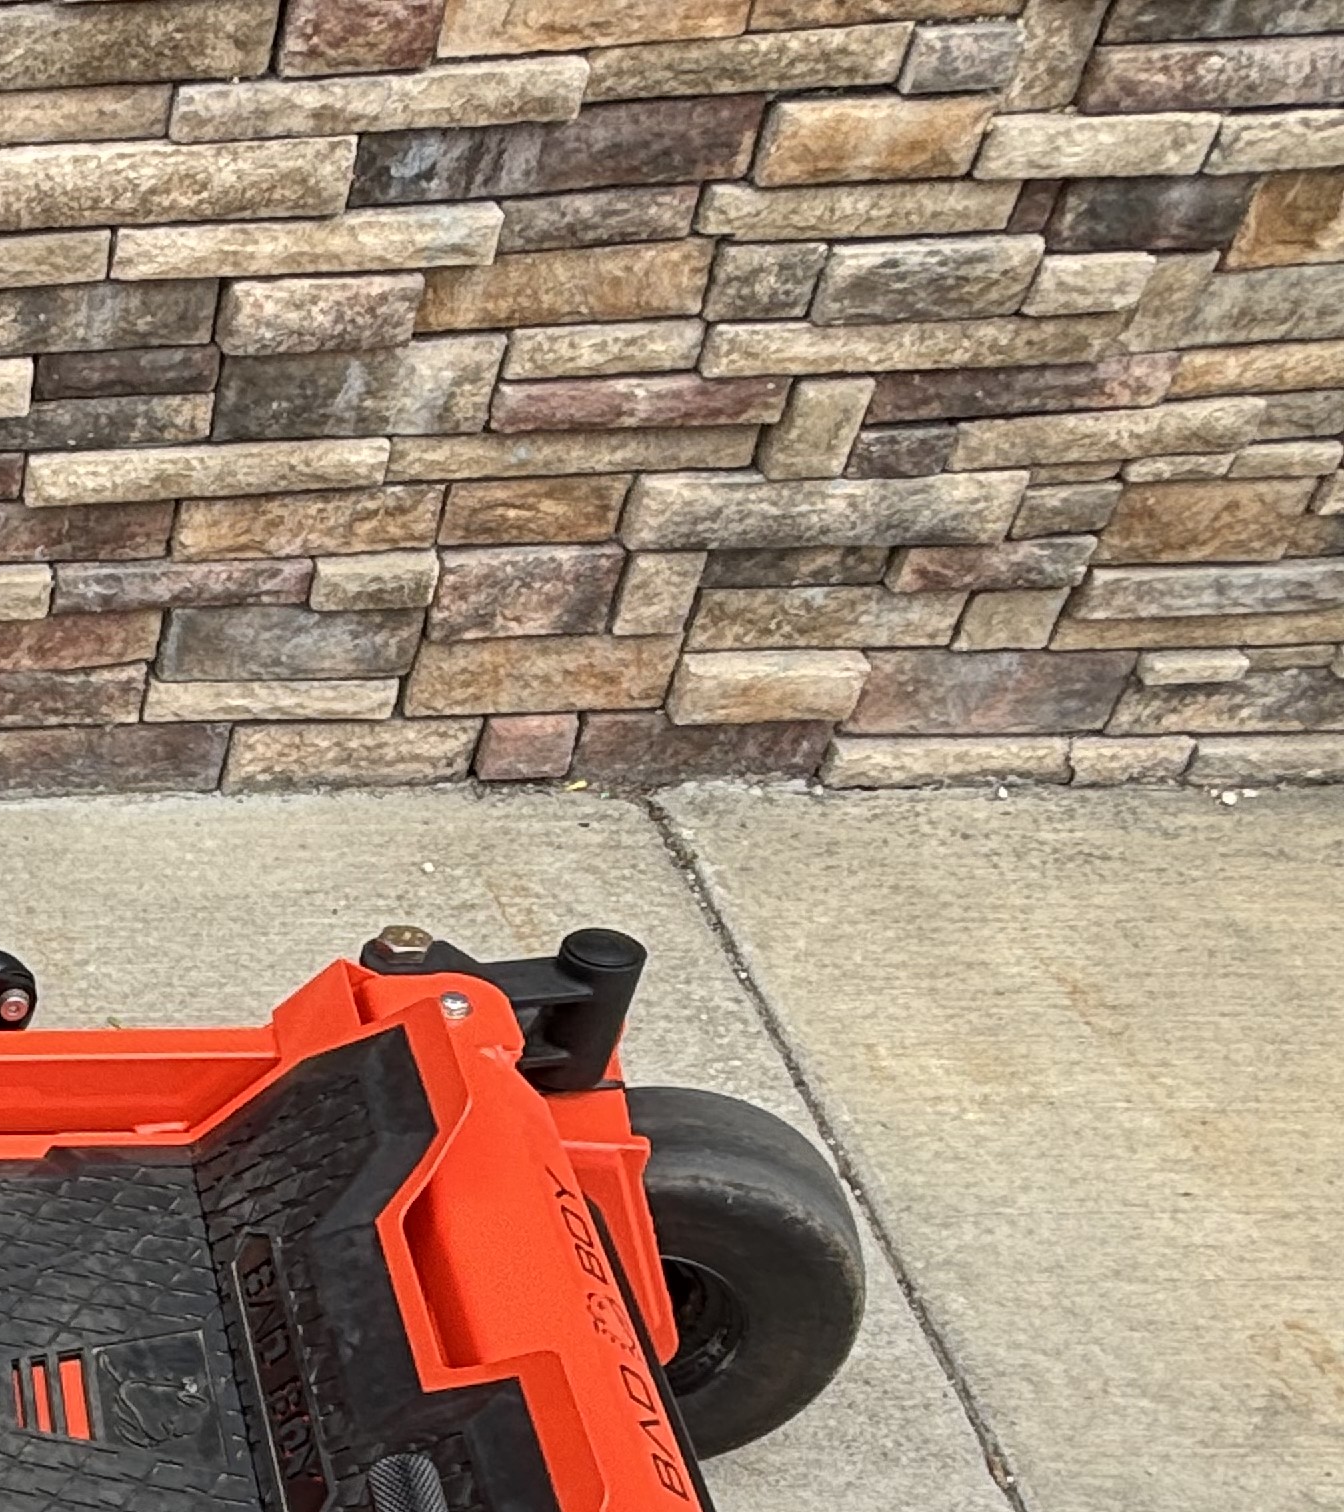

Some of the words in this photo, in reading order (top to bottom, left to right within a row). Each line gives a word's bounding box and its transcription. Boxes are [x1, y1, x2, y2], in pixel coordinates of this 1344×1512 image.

[545, 1165, 609, 1285] BOY
[242, 1257, 291, 1368] BAD
[620, 1365, 690, 1501] BAD
